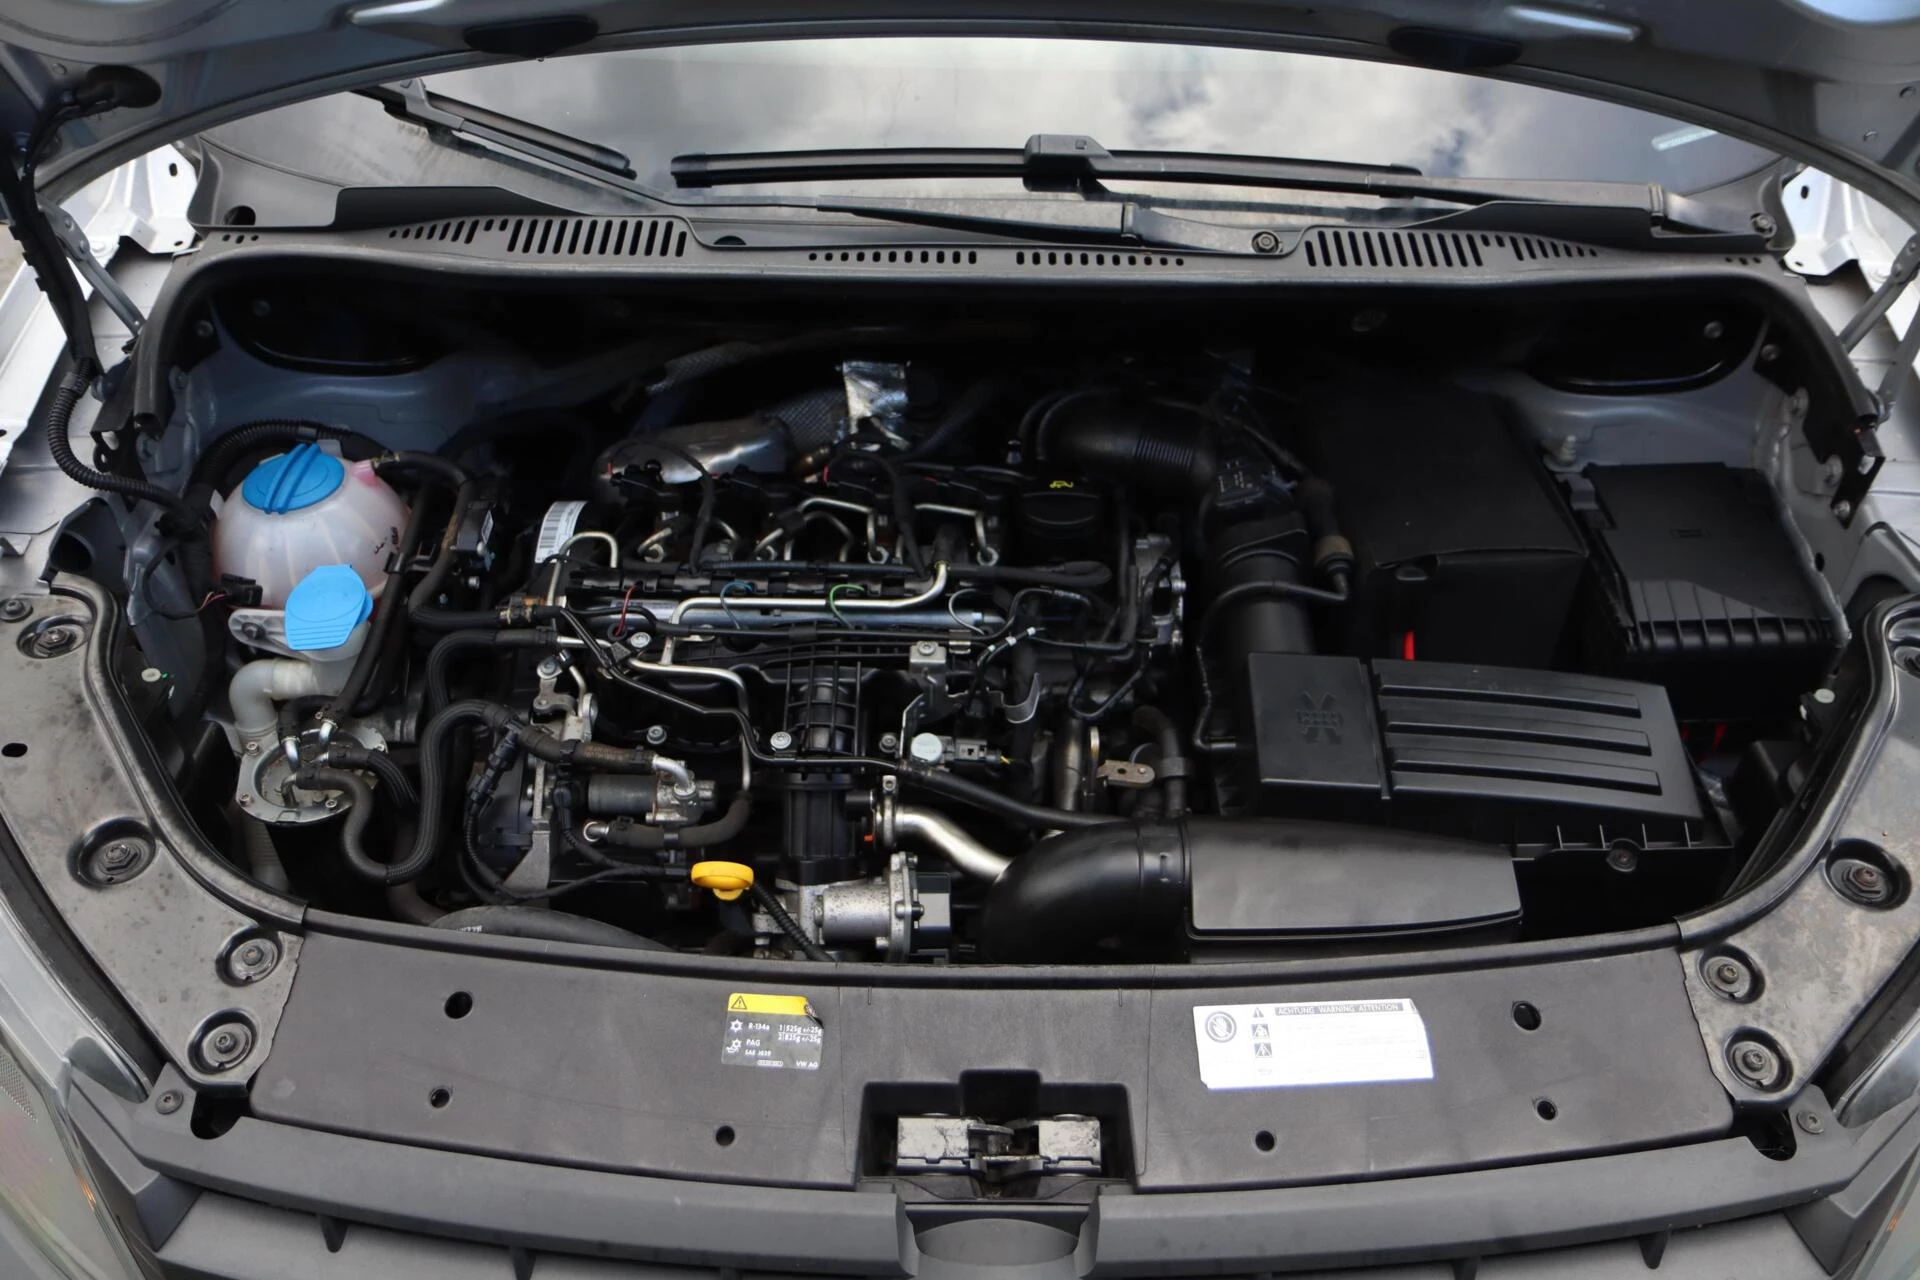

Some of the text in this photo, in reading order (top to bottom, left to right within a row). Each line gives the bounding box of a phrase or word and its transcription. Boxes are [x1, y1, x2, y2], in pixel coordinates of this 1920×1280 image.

[1278, 1003, 1399, 1015] ACHTUNG WARNING ATTENTION
[746, 1039, 761, 1047] PAG
